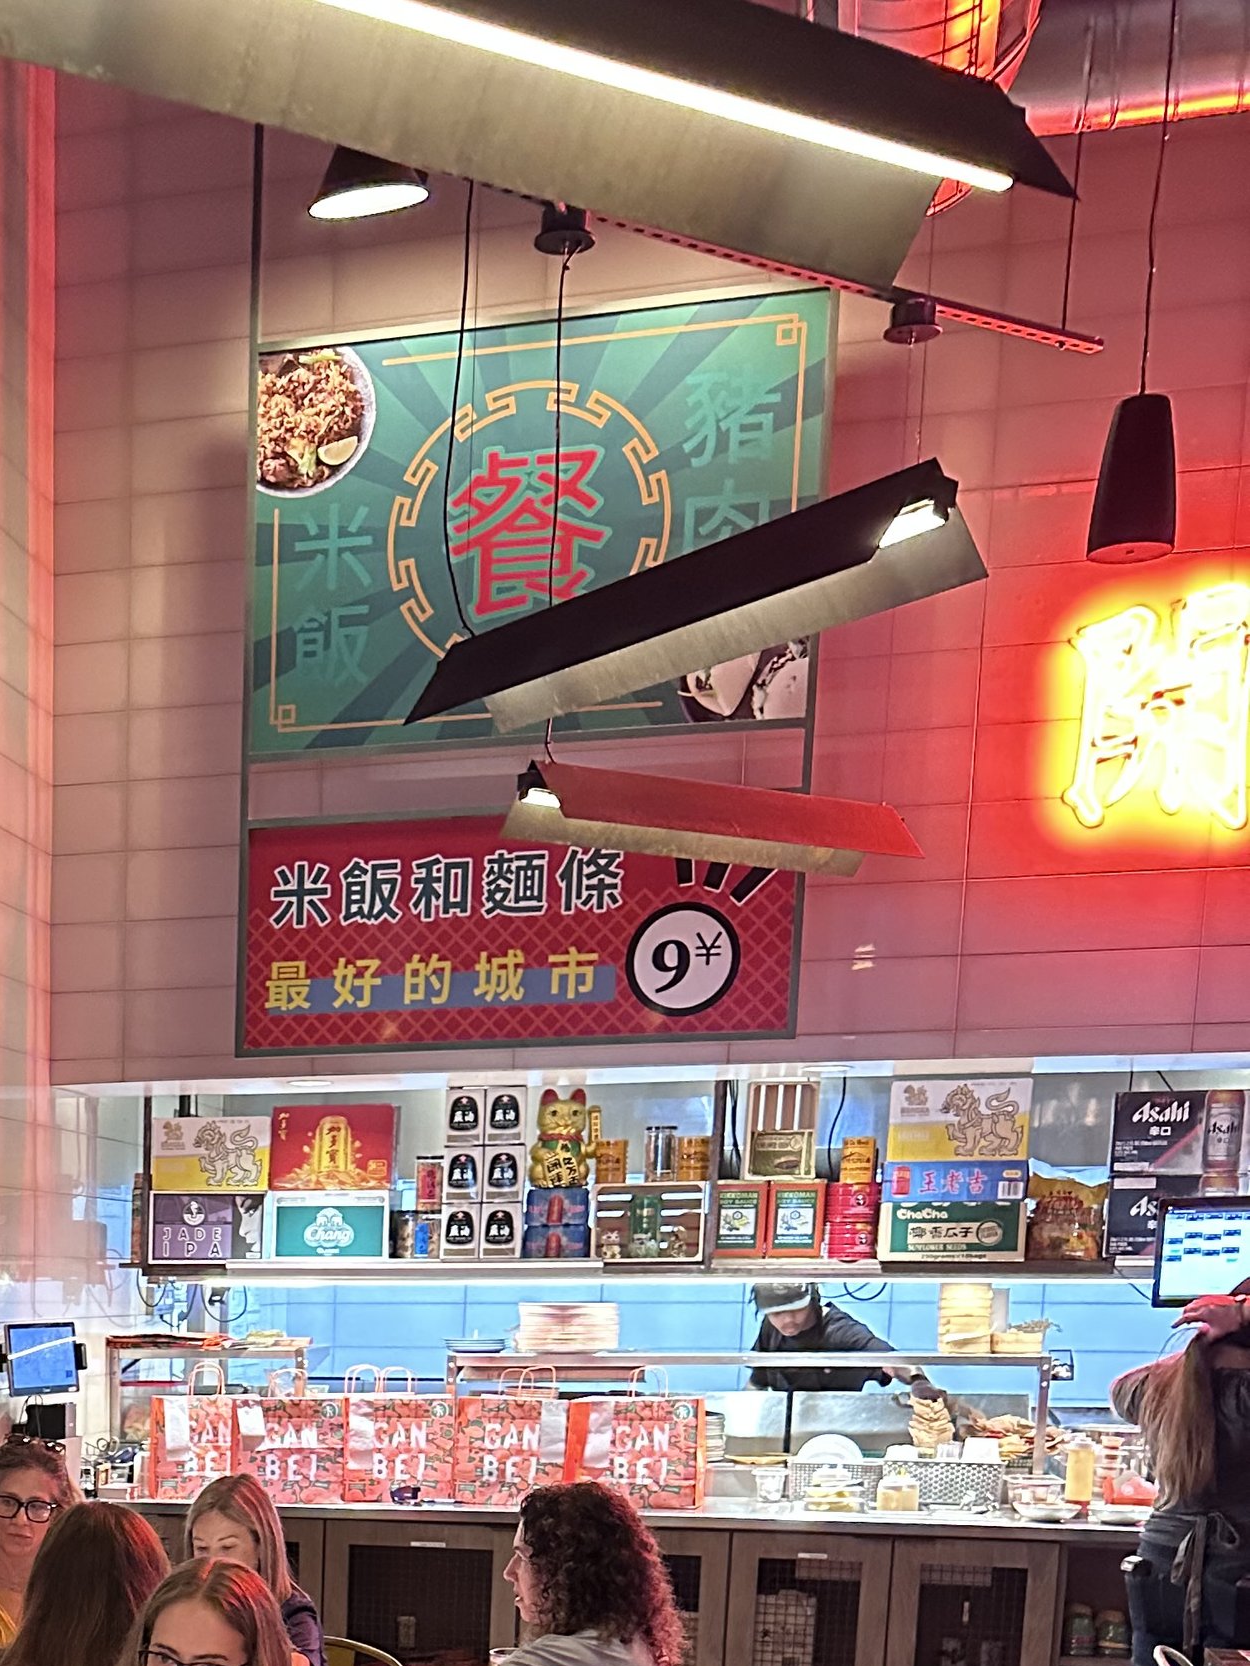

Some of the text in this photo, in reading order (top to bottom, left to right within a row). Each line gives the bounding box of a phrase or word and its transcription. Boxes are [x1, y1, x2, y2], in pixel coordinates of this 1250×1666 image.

[451, 445, 606, 618] 餐
[293, 502, 374, 687] 米飯
[268, 845, 625, 930] 米飯和麵條
[265, 946, 599, 1012] 最好的城市
[1132, 1100, 1190, 1123] Asahi
[918, 1168, 988, 1195] 王老吉
[896, 1207, 948, 1220] ChaCha
[162, 1227, 222, 1241] JADE
[307, 1225, 351, 1244] Chang
[162, 1241, 222, 1258] IPA
[265, 1422, 318, 1448] GAN
[374, 1421, 426, 1449] GAN
[484, 1423, 540, 1451] GAN
[615, 1423, 669, 1452] GAN
[265, 1453, 318, 1481] BEI
[373, 1452, 425, 1481] BEI
[483, 1455, 537, 1484] BEI
[614, 1456, 668, 1485] BEI
